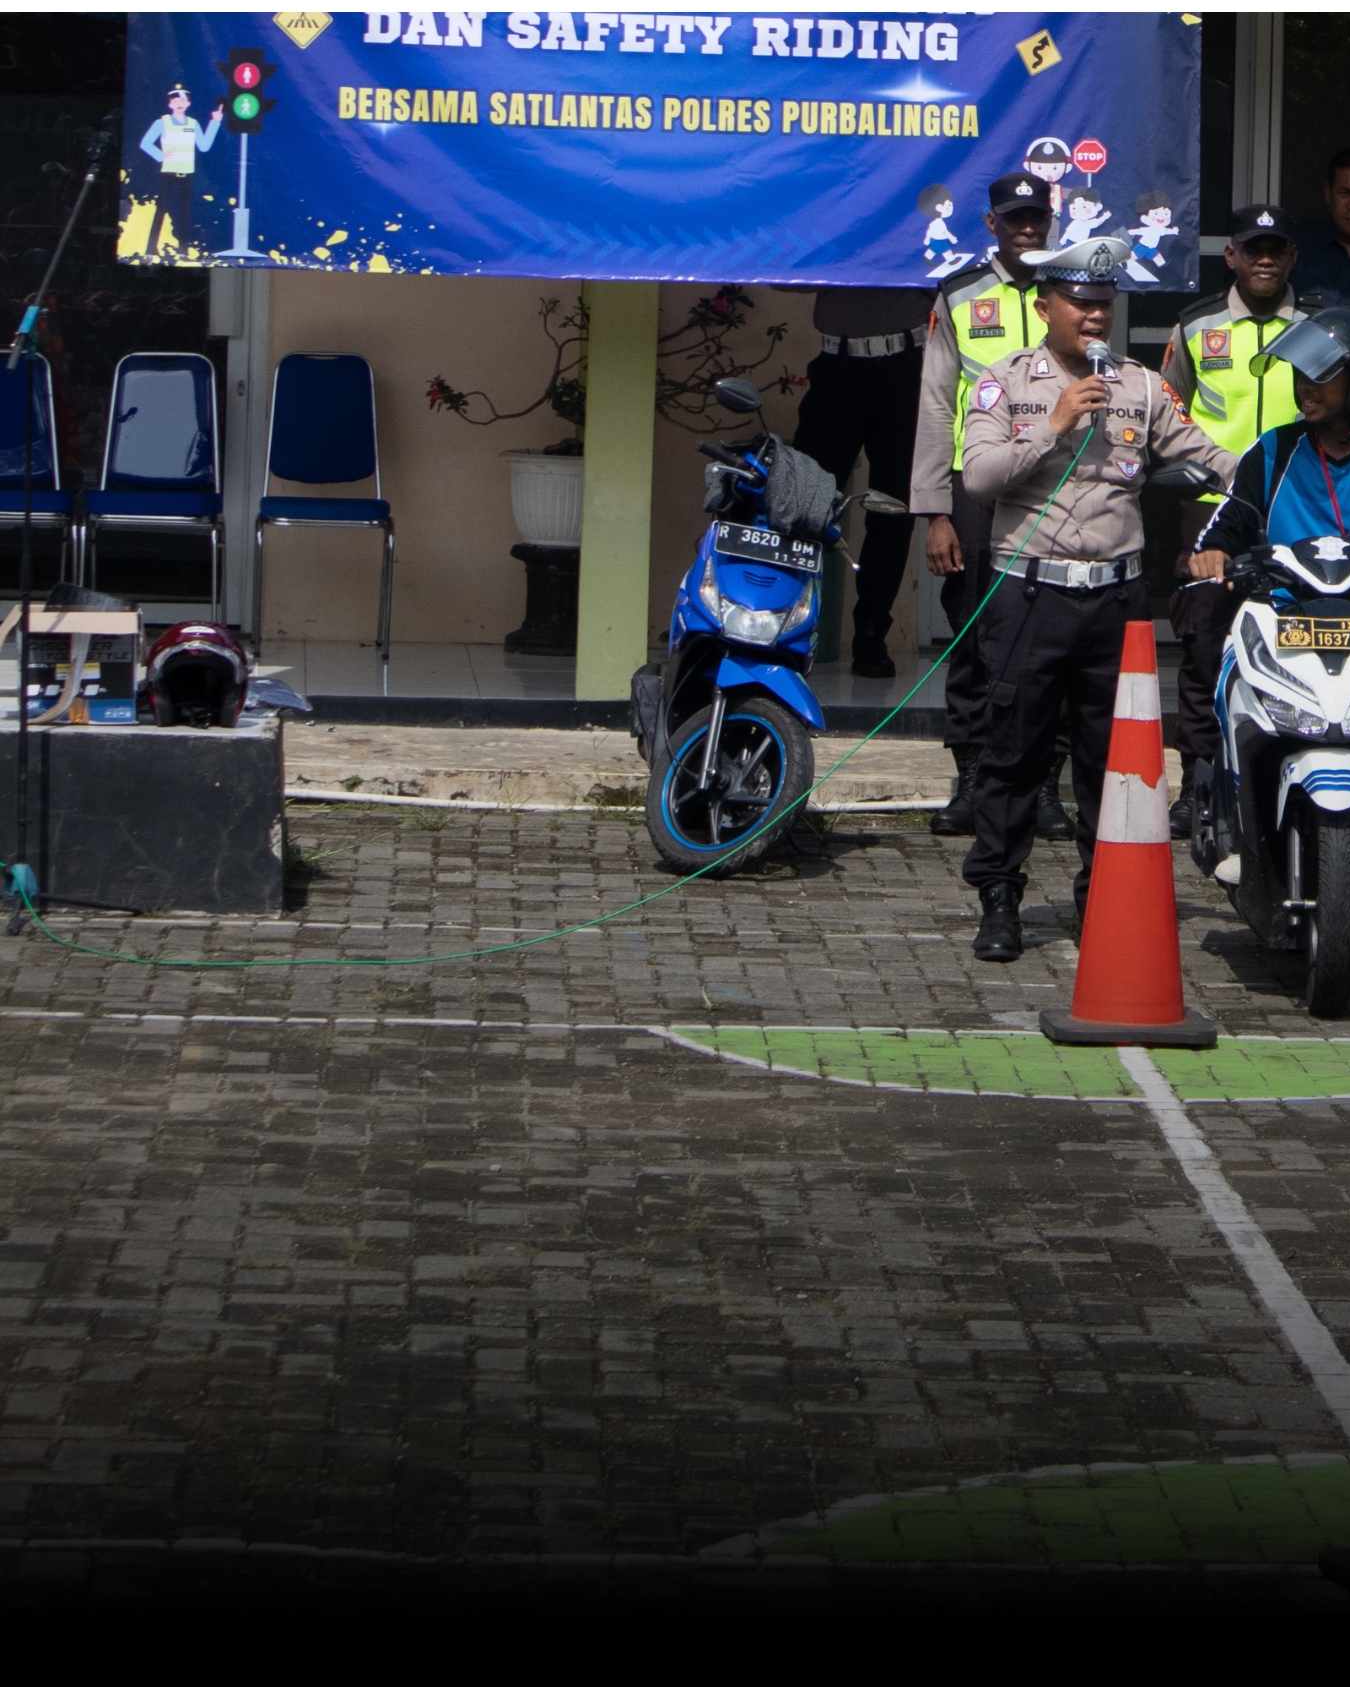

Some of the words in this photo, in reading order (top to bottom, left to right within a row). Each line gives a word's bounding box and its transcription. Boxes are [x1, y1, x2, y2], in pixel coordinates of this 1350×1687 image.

[364, 12, 483, 47] DAN
[506, 13, 730, 55] SAFETY
[751, 18, 959, 62] RIDING
[339, 87, 478, 124] BERSAMA
[490, 92, 652, 130] SATLANTAS
[663, 97, 771, 134] POLRES
[781, 99, 979, 139] PURBALINGGA
[1077, 152, 1103, 161] STOP
[971, 327, 1003, 337] BEATUS
[1107, 407, 1146, 421] POLRI
[719, 525, 730, 538] R
[741, 529, 781, 547] 3620
[792, 540, 814, 556] DM
[1318, 633, 1350, 647] 1637
